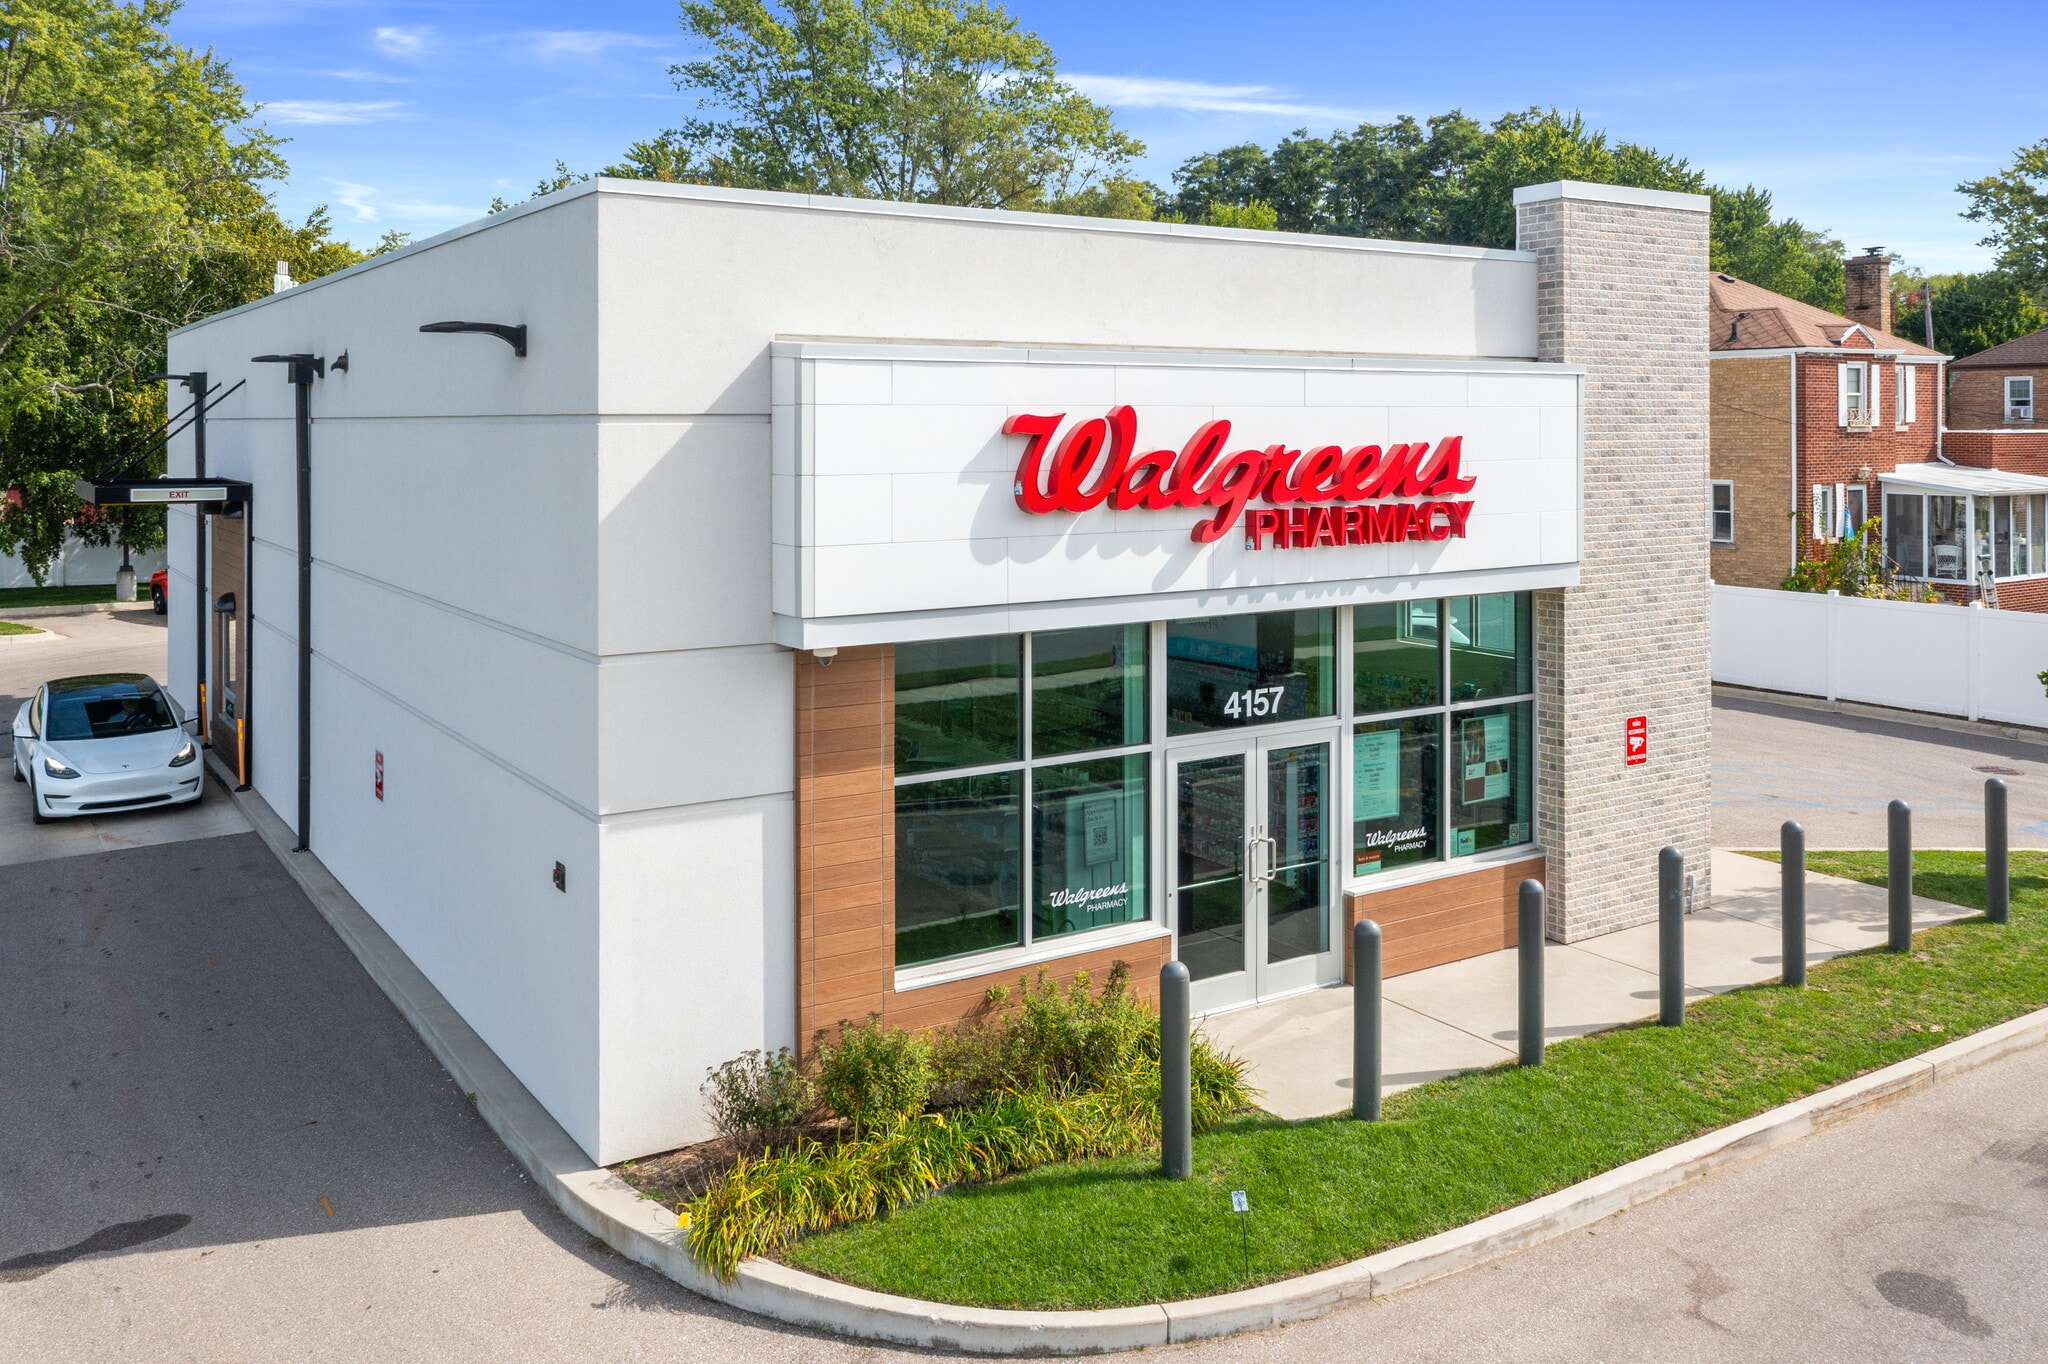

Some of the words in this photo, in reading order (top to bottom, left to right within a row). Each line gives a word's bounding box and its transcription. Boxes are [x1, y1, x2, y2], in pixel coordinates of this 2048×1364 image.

[1001, 404, 1477, 544] Walgreens
[168, 490, 190, 499] EXIT
[1245, 500, 1475, 551] PHARMACY
[1223, 686, 1285, 719] 4157
[1366, 826, 1428, 848] Walgreens
[1394, 840, 1427, 853] PHARMACY
[1049, 882, 1128, 907] Walgreens
[1087, 898, 1128, 913] PHARMACY
